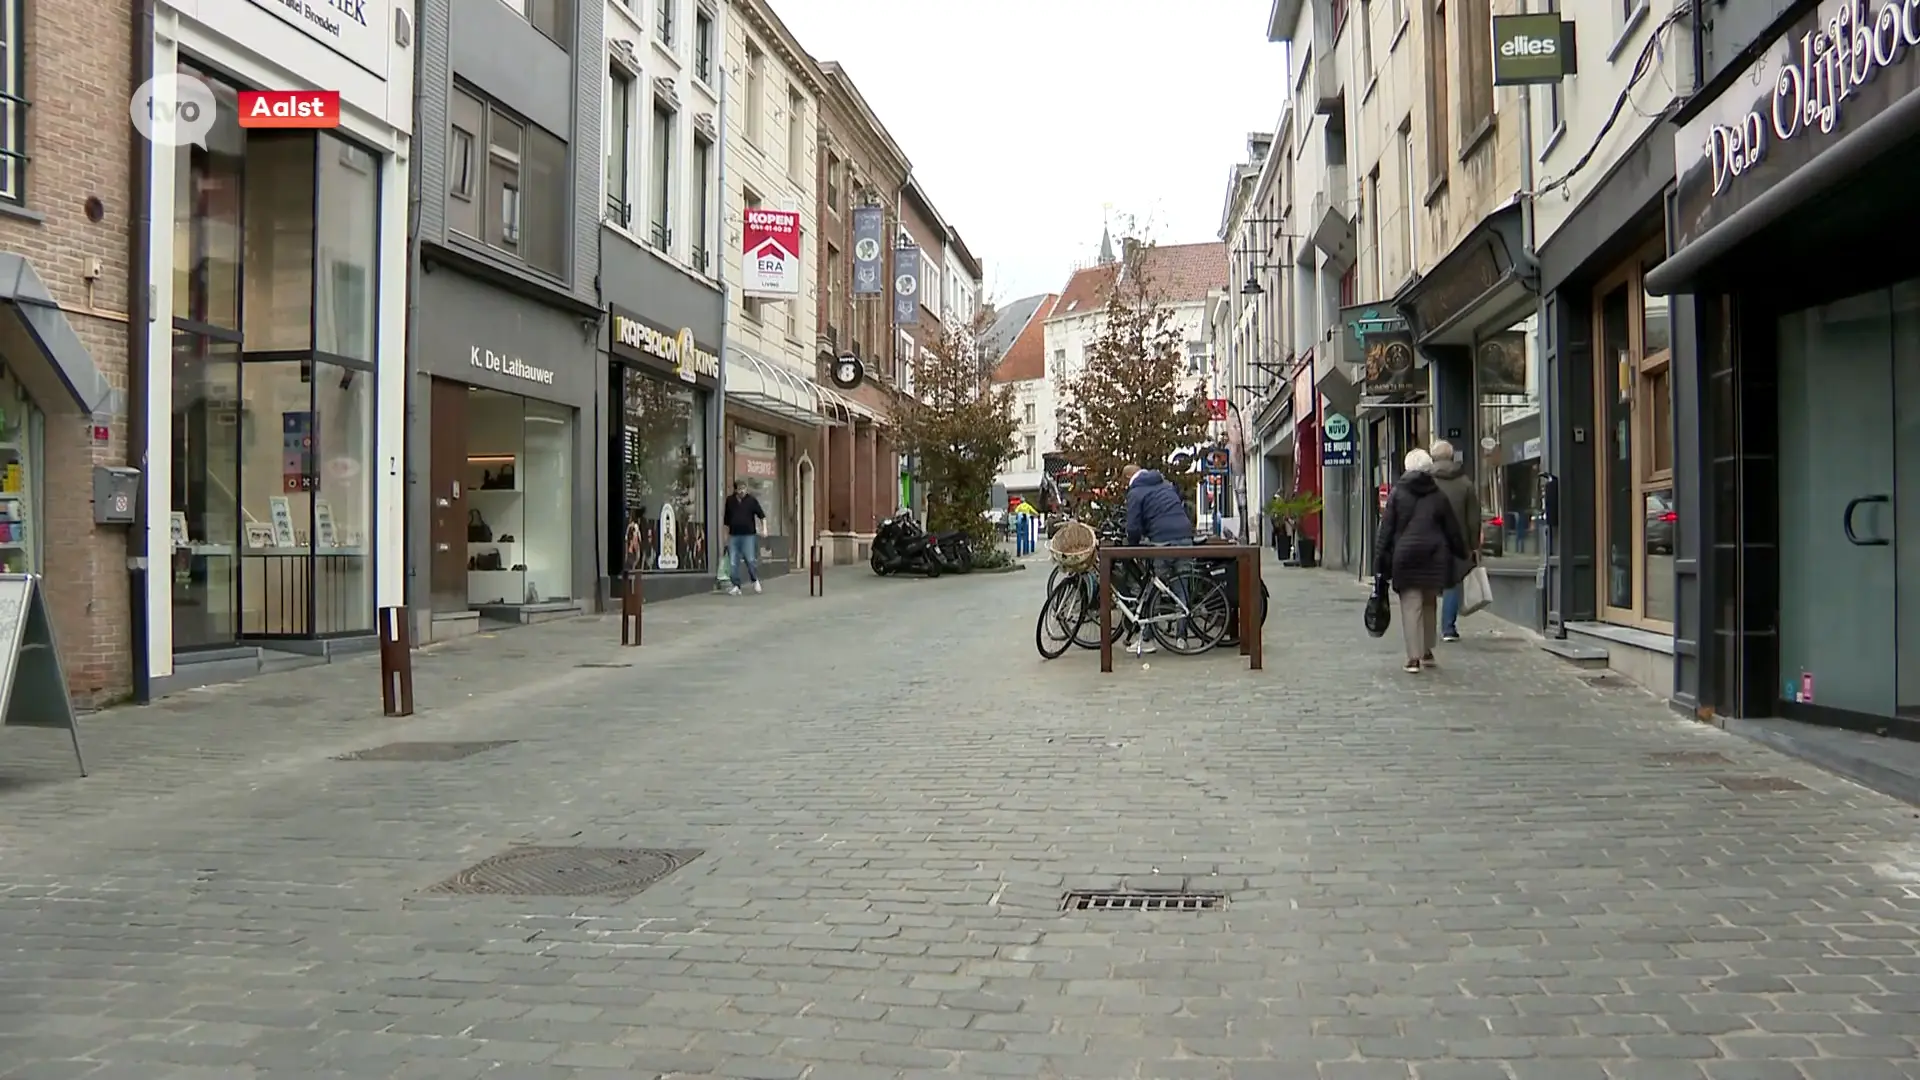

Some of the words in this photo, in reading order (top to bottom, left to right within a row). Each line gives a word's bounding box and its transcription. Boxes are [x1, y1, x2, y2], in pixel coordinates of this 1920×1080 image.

[304, 4, 340, 37] Brondeel
[1500, 35, 1556, 56] ellies
[1706, 112, 1762, 197] Den
[748, 212, 794, 226] KOPEN
[758, 260, 783, 272] ERA
[615, 316, 680, 364] KAPSALON
[694, 348, 719, 379] KING
[471, 345, 482, 367] K.
[485, 349, 500, 371] De
[502, 354, 554, 385] Lathauwer
[1328, 424, 1346, 434] NUVO
[1324, 441, 1332, 452] TE
